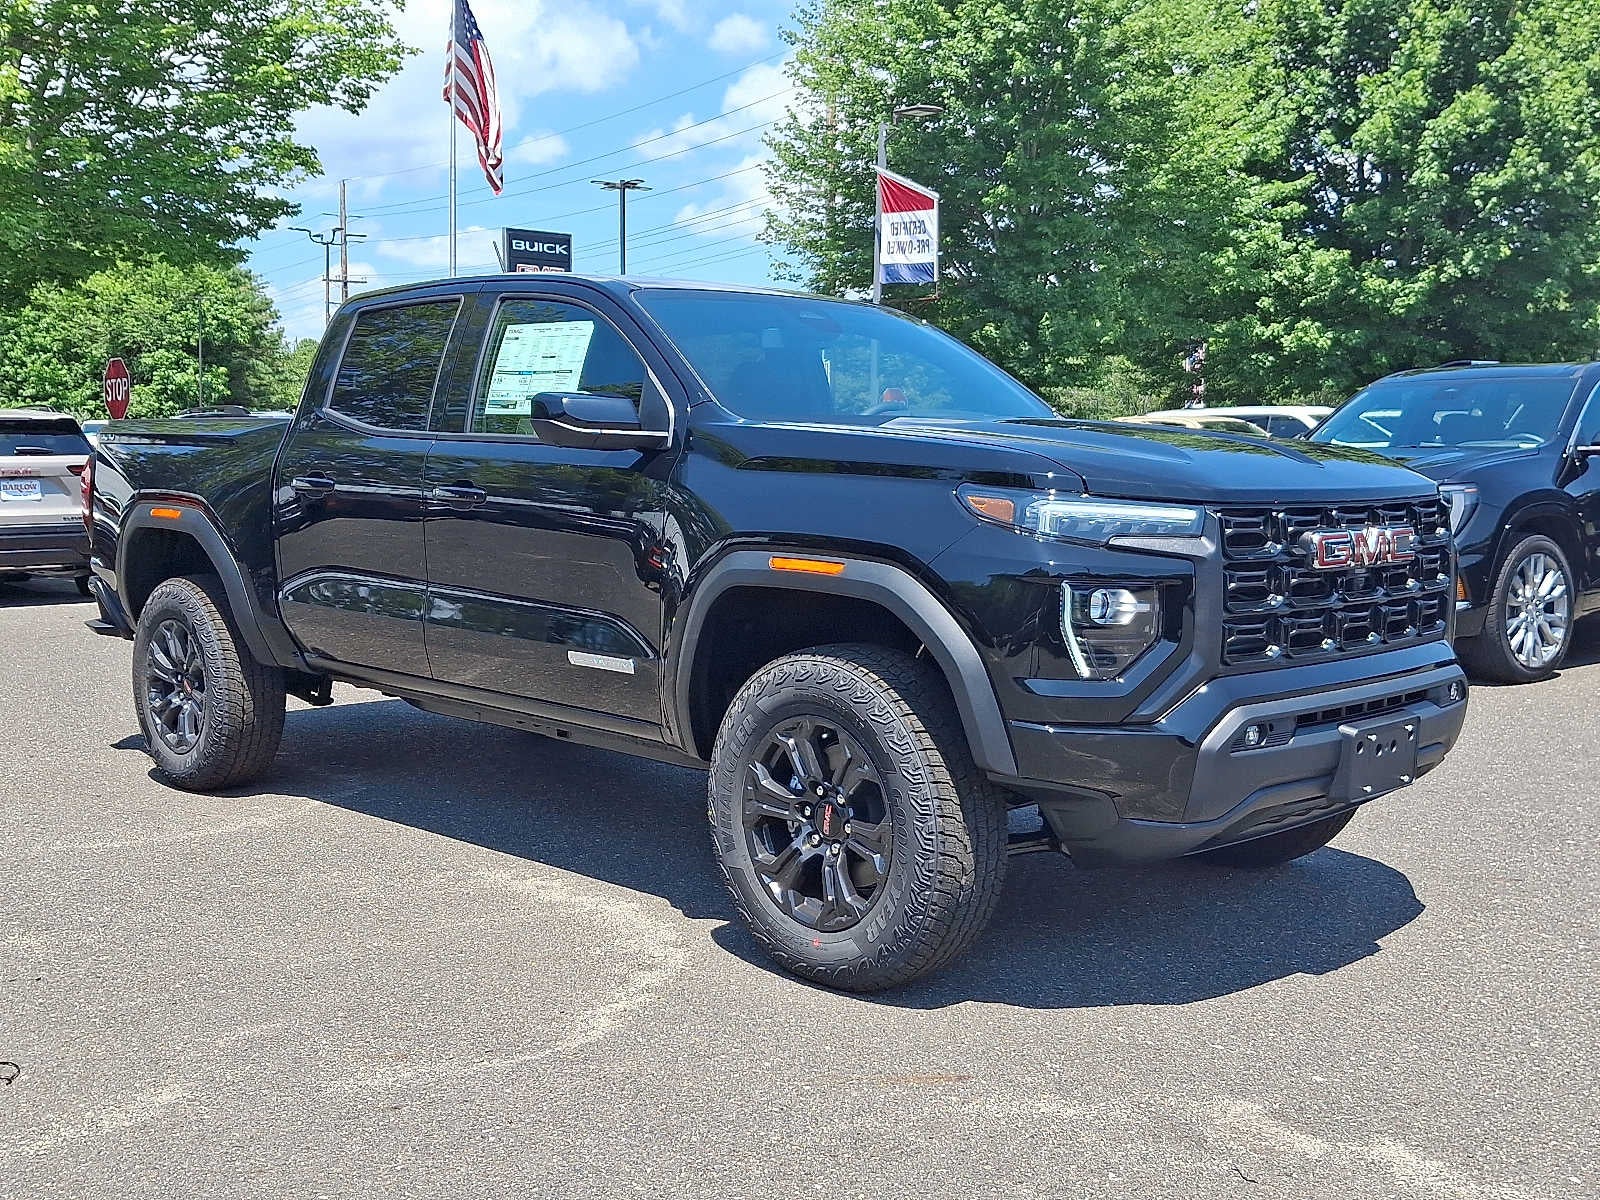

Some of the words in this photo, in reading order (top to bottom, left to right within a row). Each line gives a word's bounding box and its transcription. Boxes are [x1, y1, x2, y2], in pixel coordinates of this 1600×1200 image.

[511, 239, 569, 255] BUICK
[106, 377, 128, 401] STOP
[2, 483, 37, 493] BARLOW
[1313, 527, 1415, 568] GMC
[719, 713, 758, 854] WRANGLER
[865, 787, 909, 943] GOODYEAR
